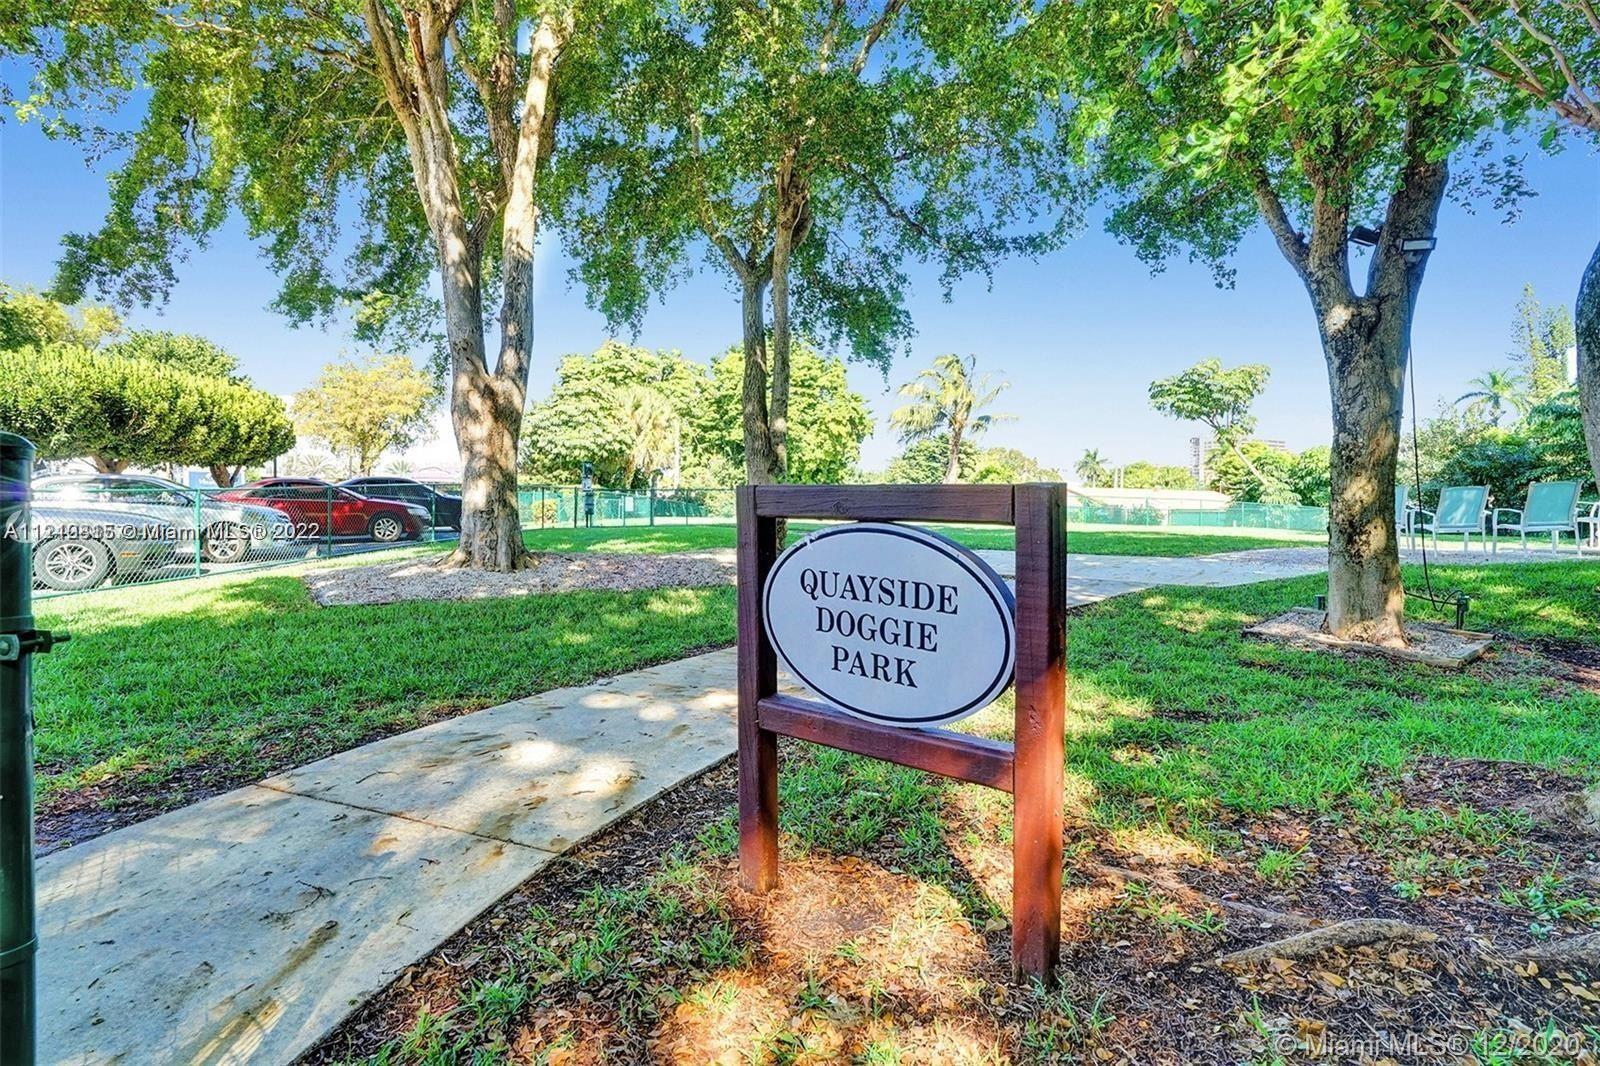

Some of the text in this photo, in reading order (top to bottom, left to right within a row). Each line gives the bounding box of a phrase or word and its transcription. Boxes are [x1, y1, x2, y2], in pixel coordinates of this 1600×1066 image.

[800, 568, 958, 615] QUAYSIDE
[815, 606, 938, 652] DOGGIE
[831, 644, 918, 688] PARK
